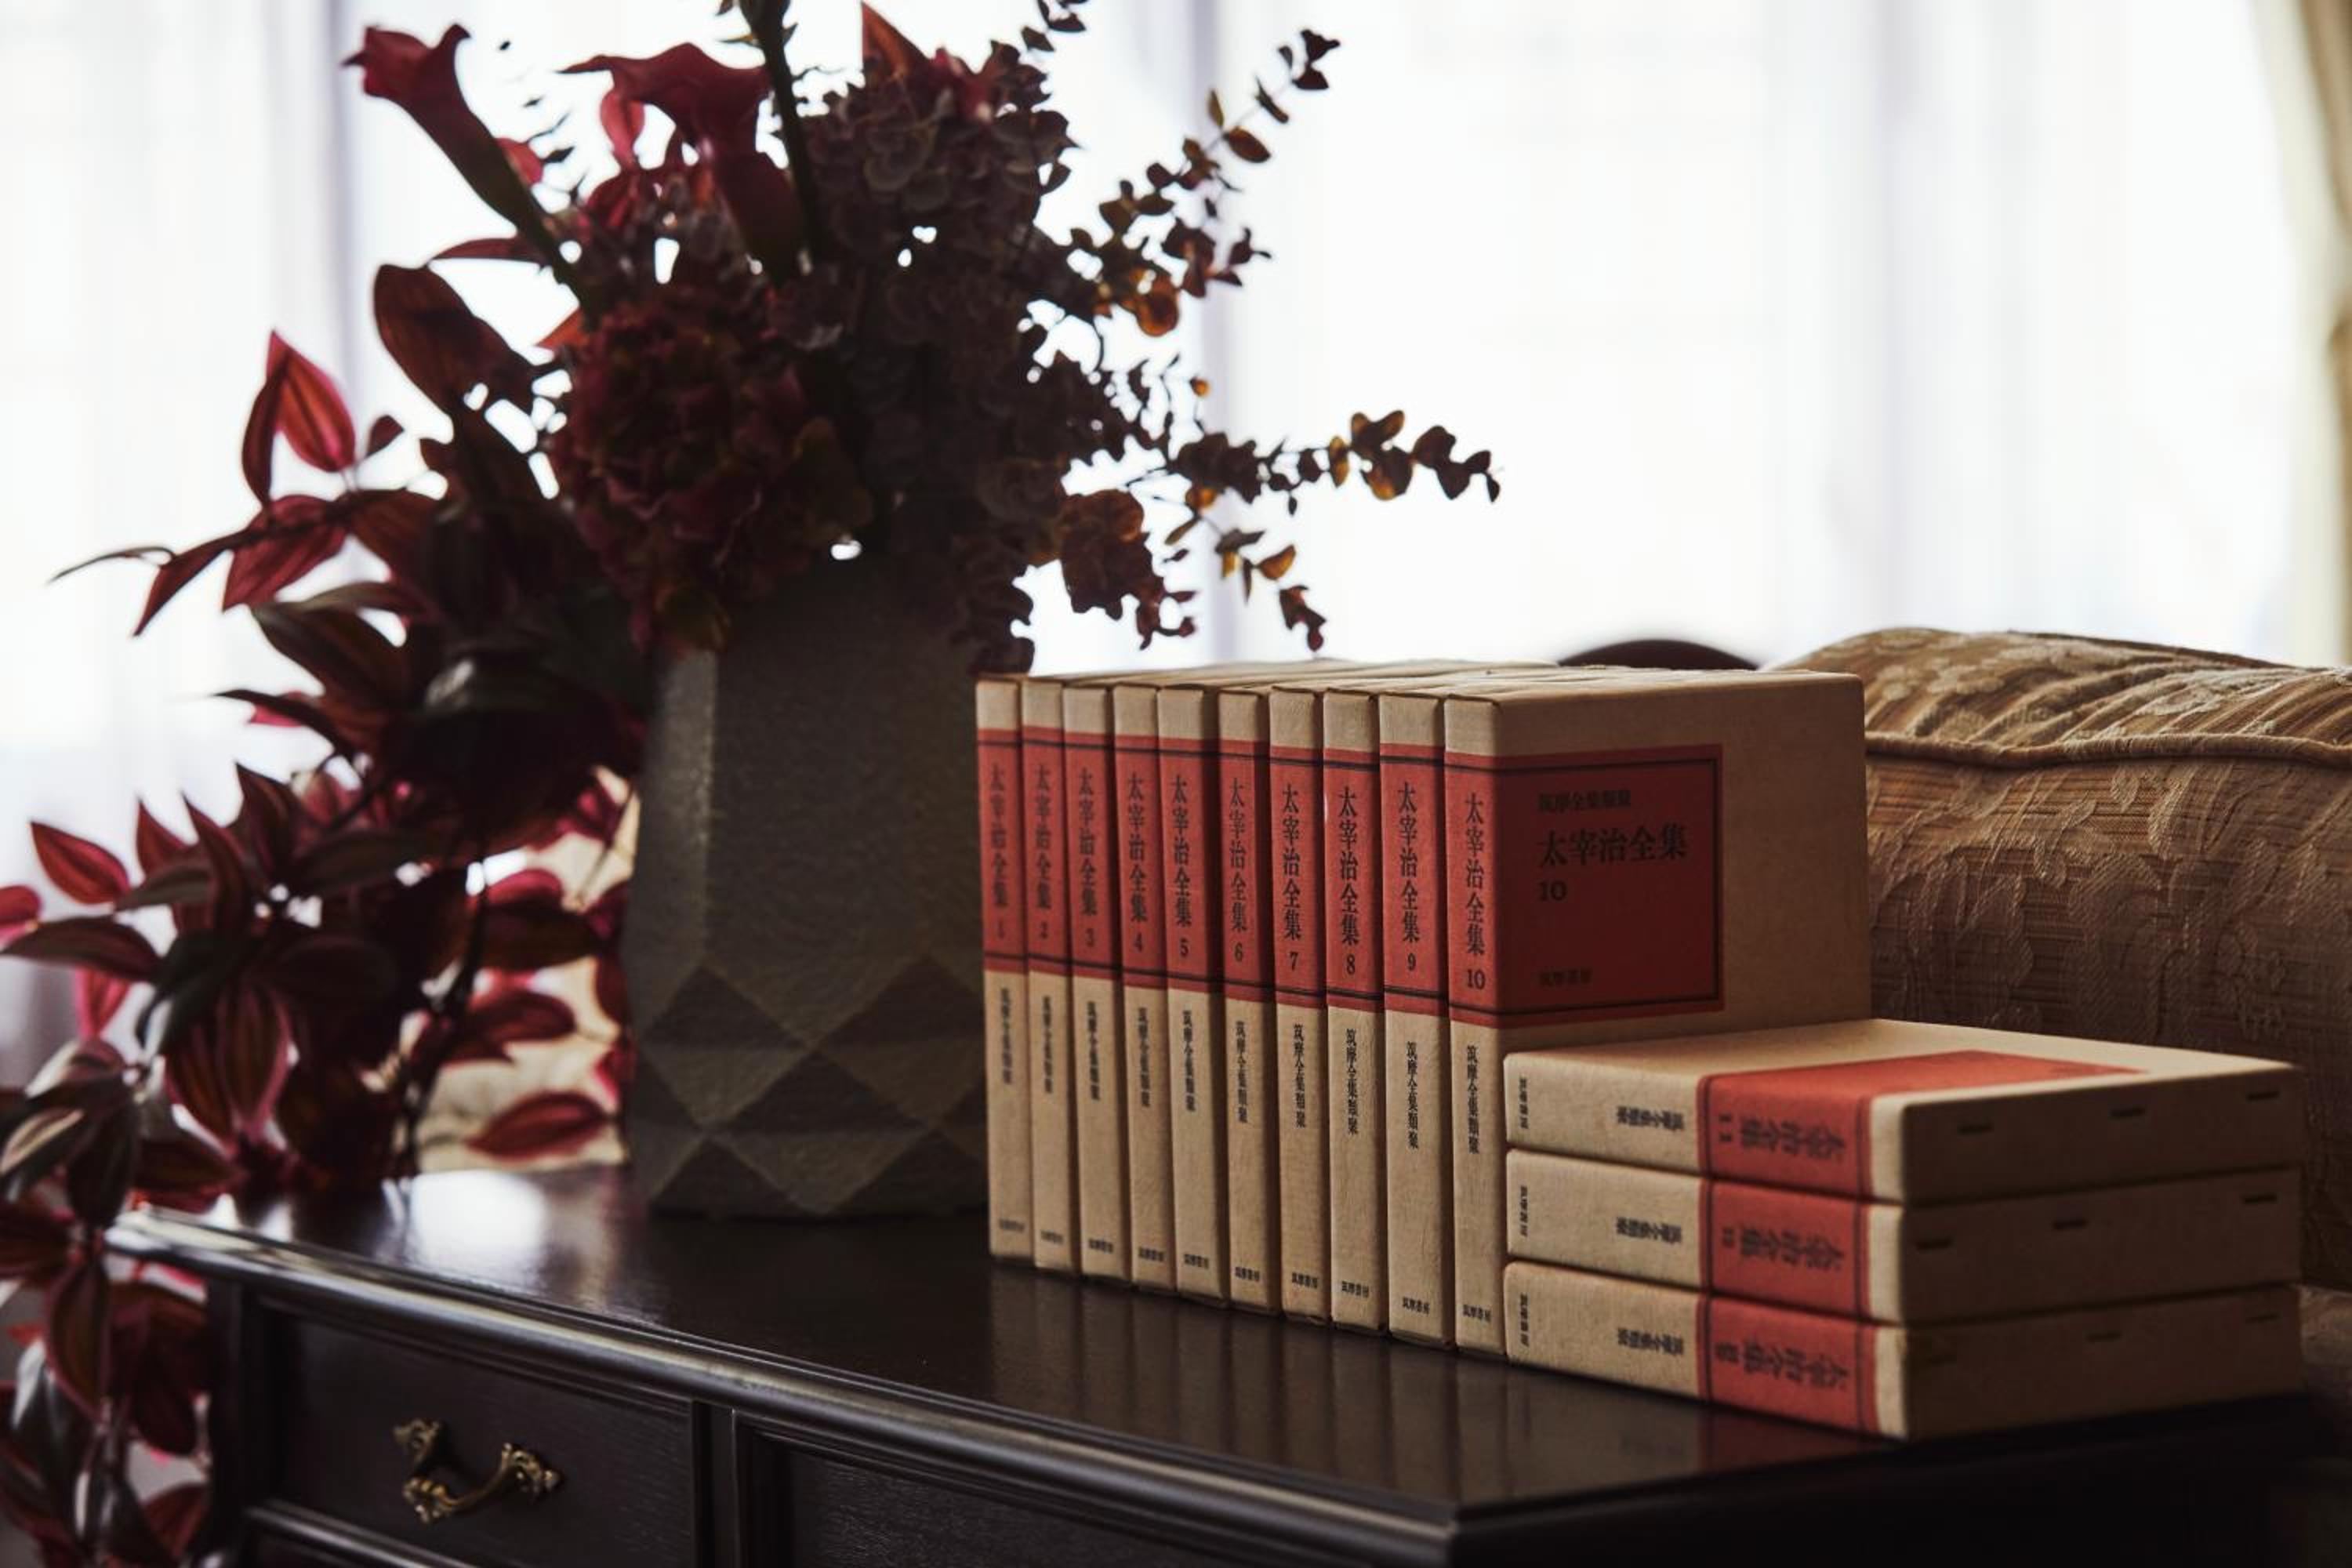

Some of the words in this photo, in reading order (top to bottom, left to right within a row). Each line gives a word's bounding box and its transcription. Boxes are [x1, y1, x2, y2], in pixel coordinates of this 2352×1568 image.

[1127, 772, 1148, 922] 太宰治全集
[1171, 775, 1192, 927] 太宰治全集
[1229, 778, 1247, 931] 太宰治全集
[1283, 784, 1301, 941] 太宰治全集
[1338, 786, 1359, 946] 太宰治全集
[1398, 782, 1420, 942] 太宰治全集
[1540, 824, 1687, 868] 太宰治全集
[1465, 793, 1485, 955] 太宰治全集
[1539, 880, 1566, 901] 10
[1179, 938, 1189, 957] 5
[1234, 943, 1243, 962] 6
[1289, 952, 1298, 971] 7
[1346, 955, 1356, 975] 8
[1407, 953, 1417, 971] 9
[1467, 969, 1486, 989] 10
